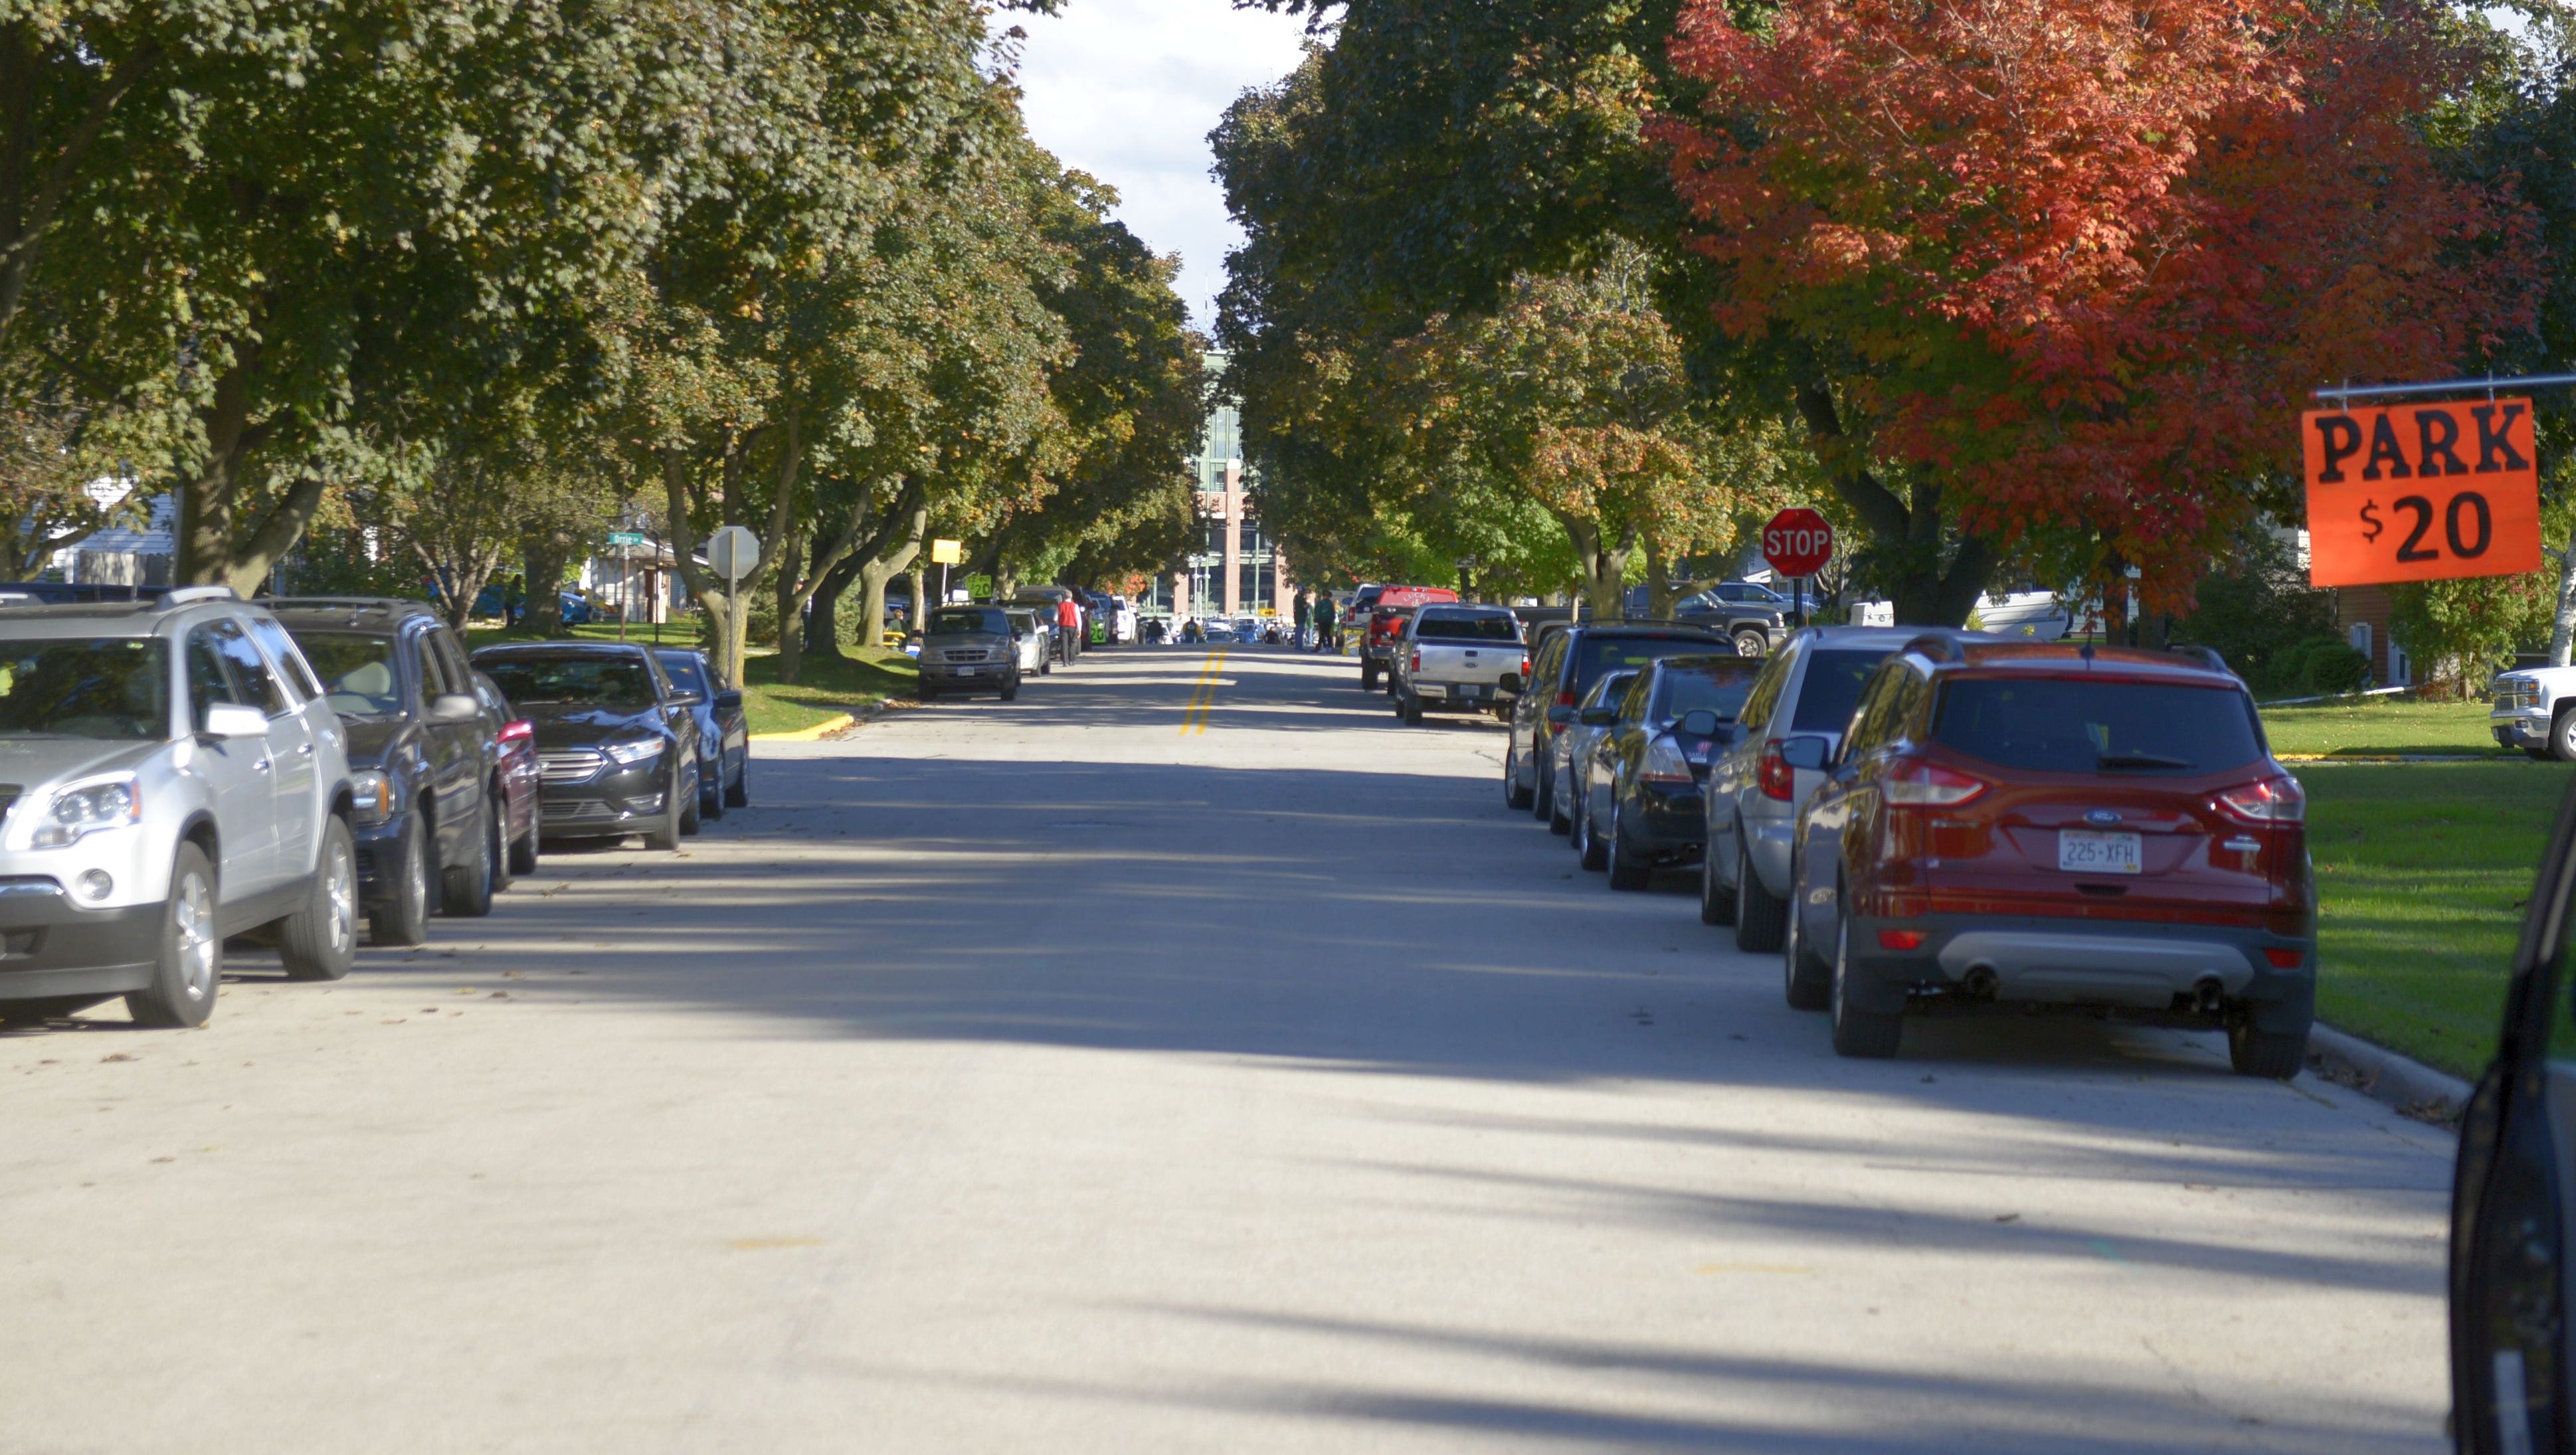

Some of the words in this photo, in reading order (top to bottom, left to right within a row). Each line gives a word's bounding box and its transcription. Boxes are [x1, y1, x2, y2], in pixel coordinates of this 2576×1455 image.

[2315, 404, 2530, 483] PARK
[2359, 491, 2492, 564] $20
[1767, 529, 1829, 556] STOP
[1403, 592, 1432, 603] LUCKY
[2067, 841, 2134, 863] 225-XFH
